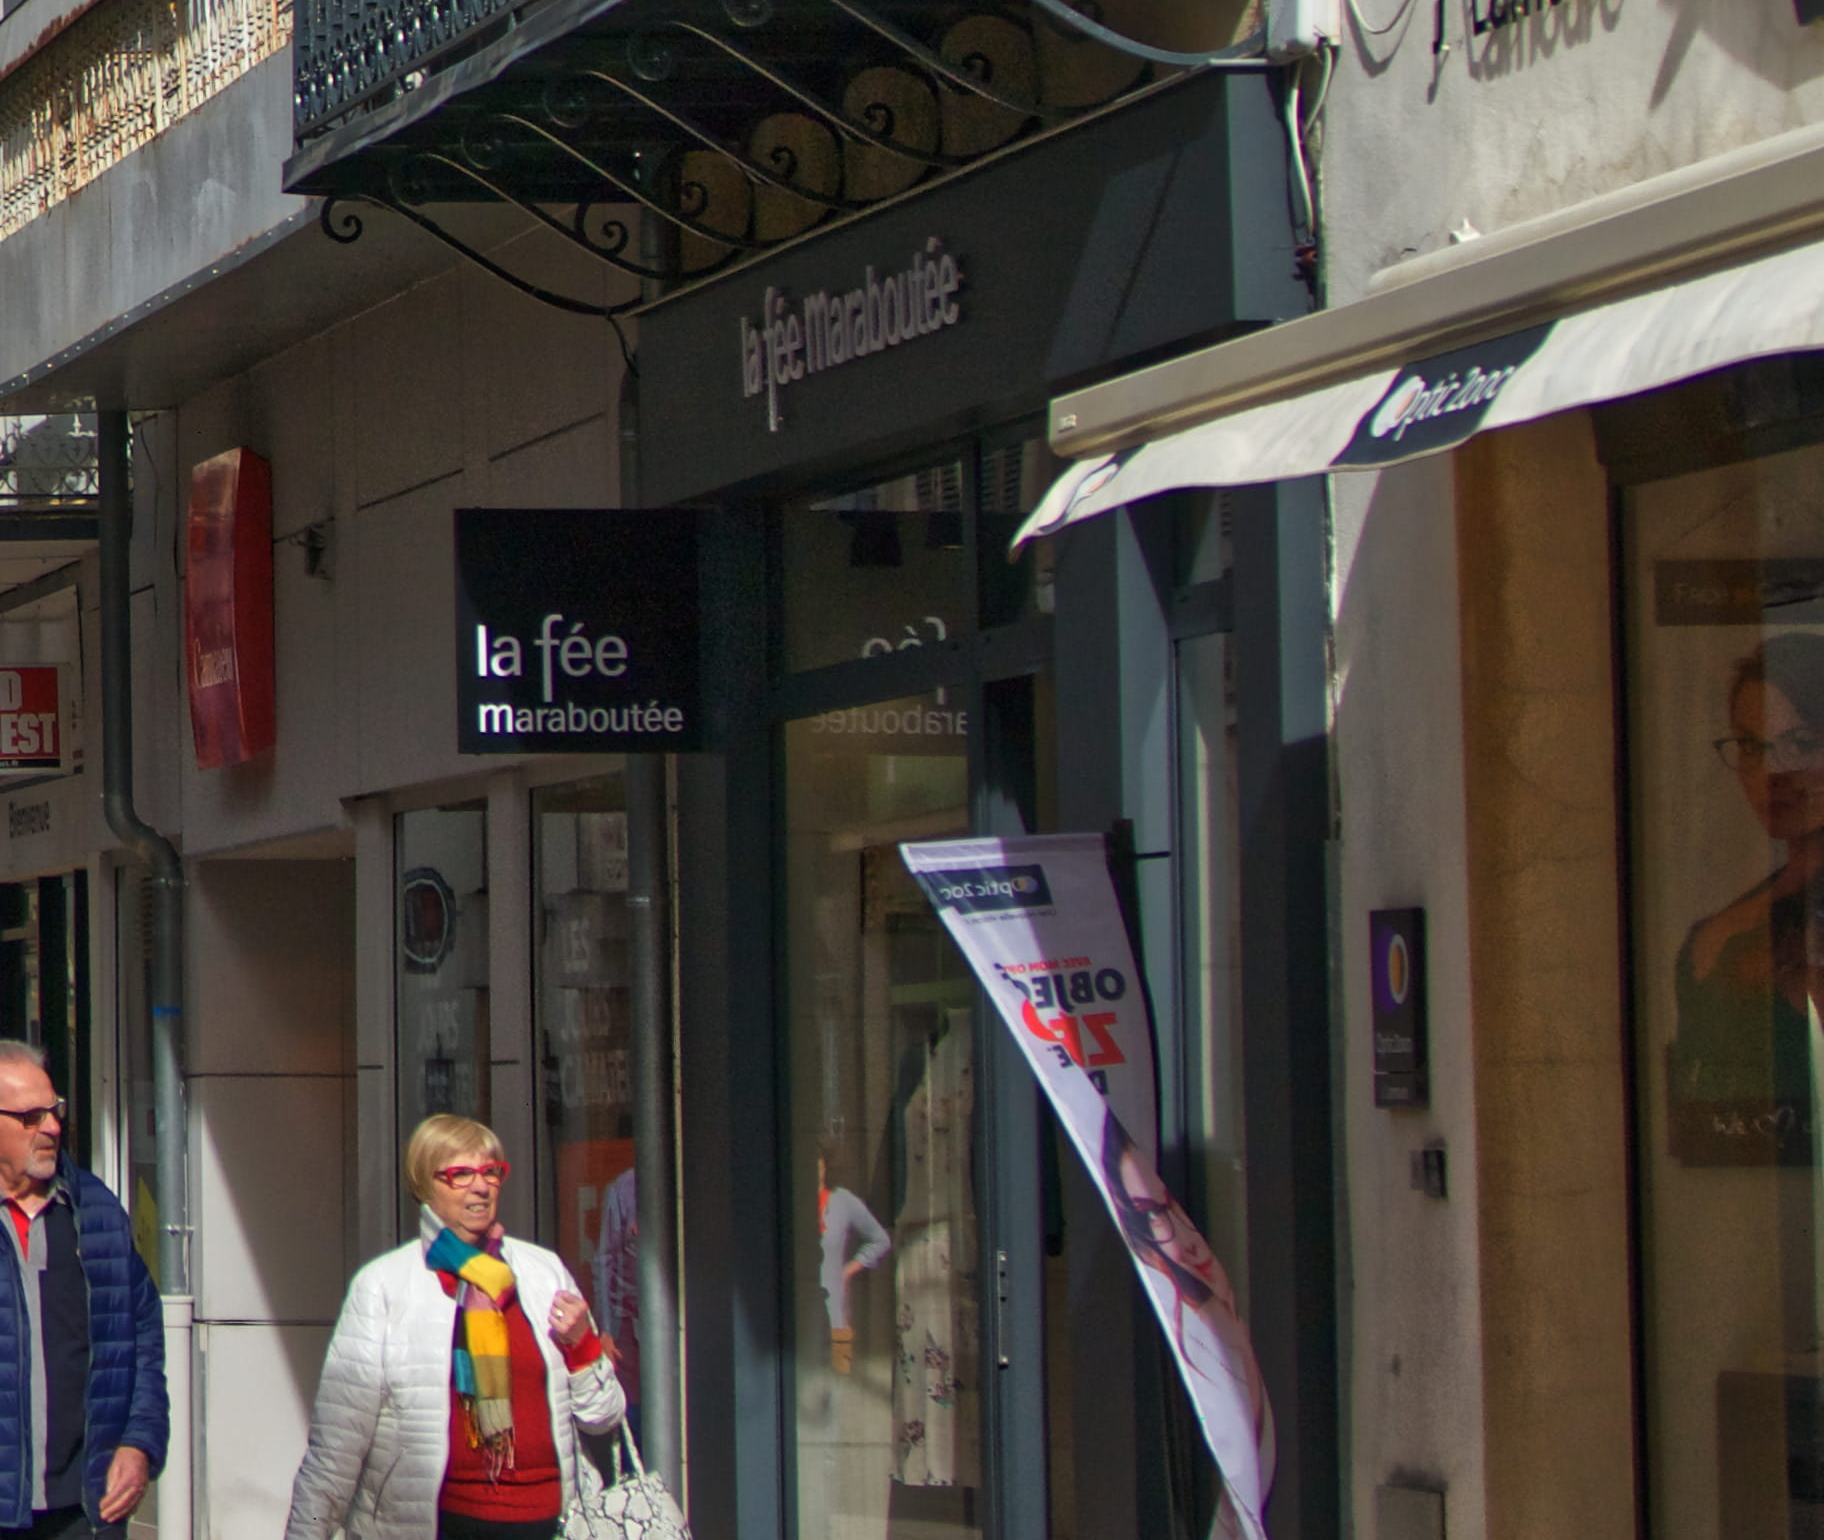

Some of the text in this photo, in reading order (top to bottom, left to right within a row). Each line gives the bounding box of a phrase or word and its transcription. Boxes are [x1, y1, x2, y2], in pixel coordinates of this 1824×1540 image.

[741, 237, 964, 432] la fée maraboutée
[476, 613, 629, 703] la fée
[478, 699, 685, 734] maraboutée
